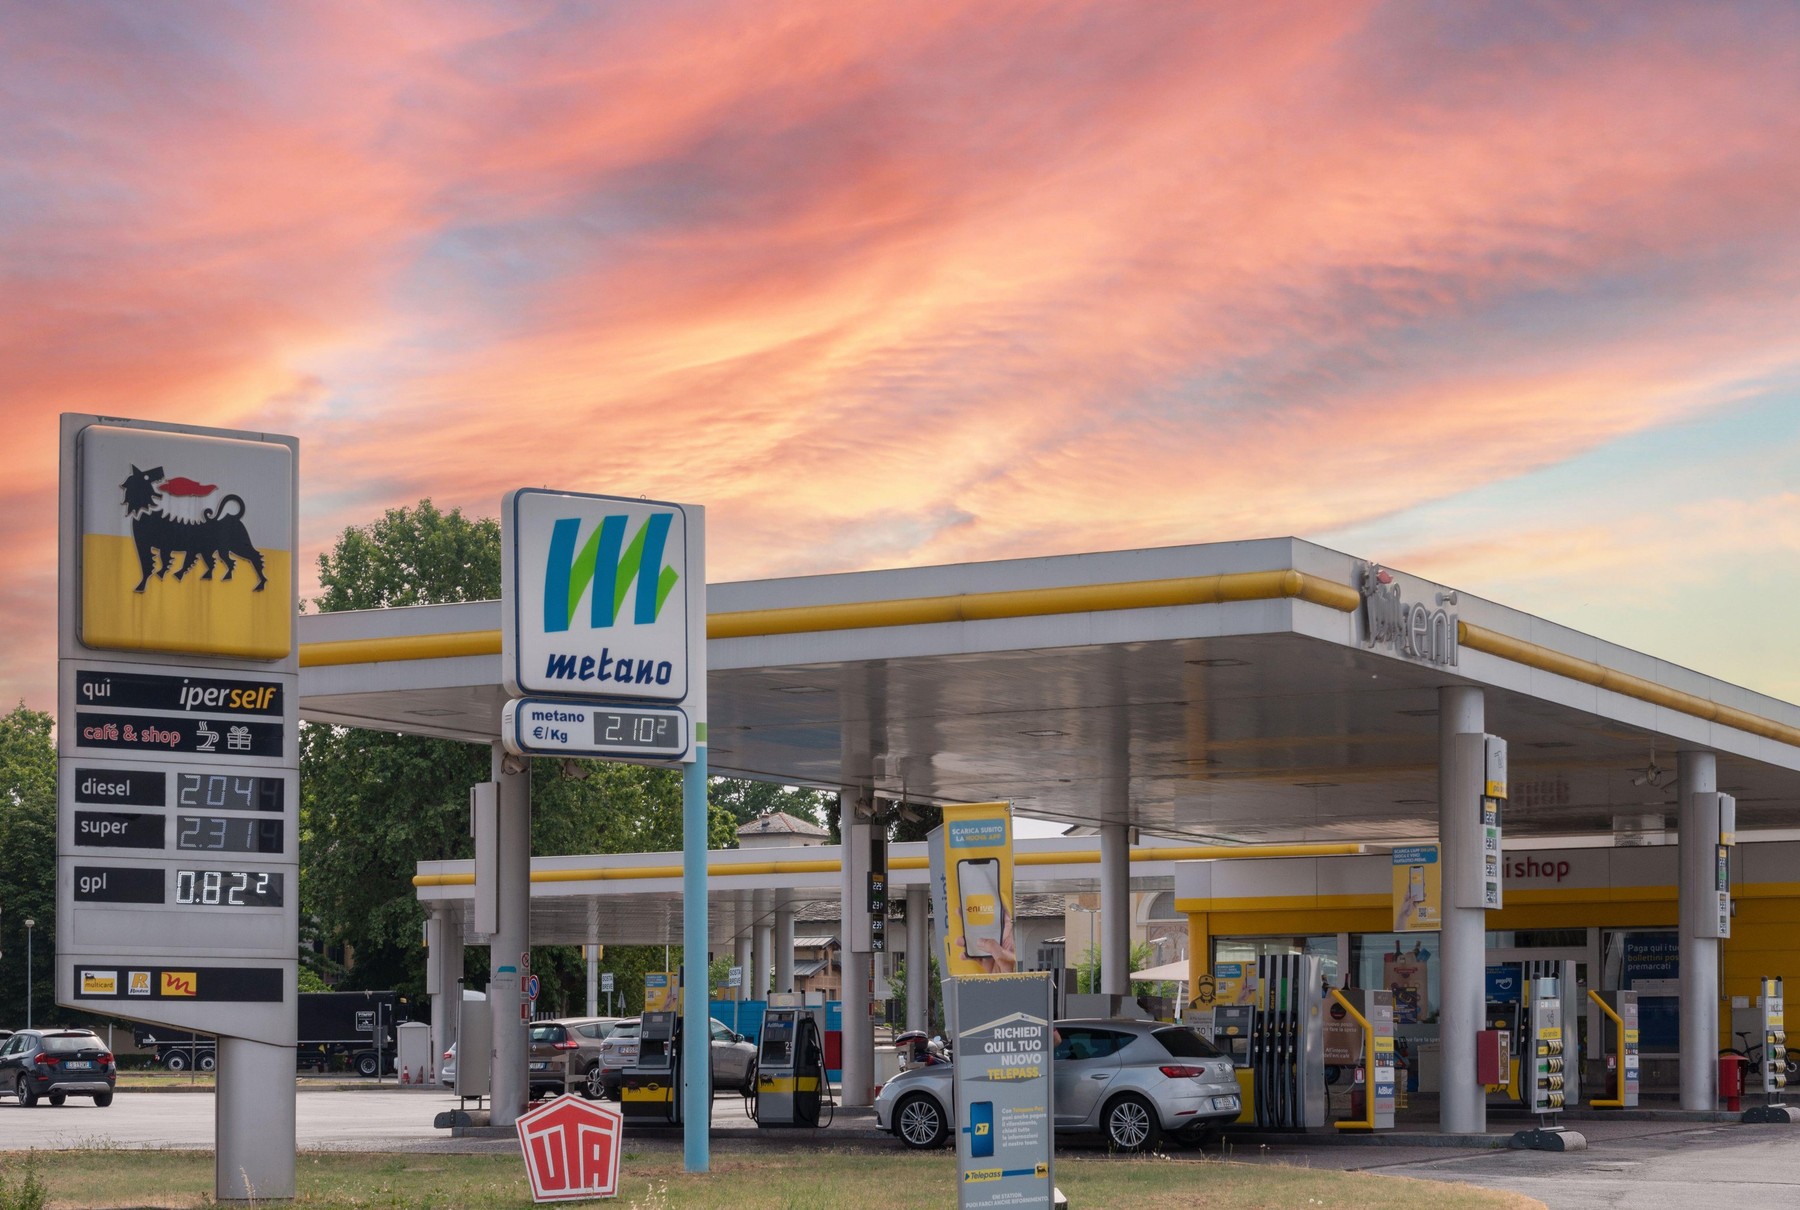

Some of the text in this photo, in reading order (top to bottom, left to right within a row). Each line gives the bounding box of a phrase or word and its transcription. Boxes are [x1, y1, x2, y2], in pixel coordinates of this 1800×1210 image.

[545, 647, 672, 686] metano
[82, 678, 277, 711] qui iperself
[532, 710, 585, 723] metano
[83, 723, 181, 747] café & shop
[533, 726, 568, 743] €/Kg
[81, 777, 131, 796] diesel
[81, 819, 128, 837] super
[951, 827, 980, 835] SCARICA
[80, 872, 107, 893] gpl
[1627, 944, 1648, 954] Paga
[1650, 943, 1663, 953] qui
[1627, 954, 1663, 962] bollettini
[1627, 962, 1671, 972] premarcati
[994, 1026, 1041, 1039] RICHIEDI
[984, 1040, 1042, 1053] QUI IL TUO
[1001, 1053, 1042, 1066] NUOVO
[987, 1066, 1042, 1080] TELEPASS.
[526, 1104, 614, 1191] UTA
[971, 1172, 1001, 1180] Telepass
